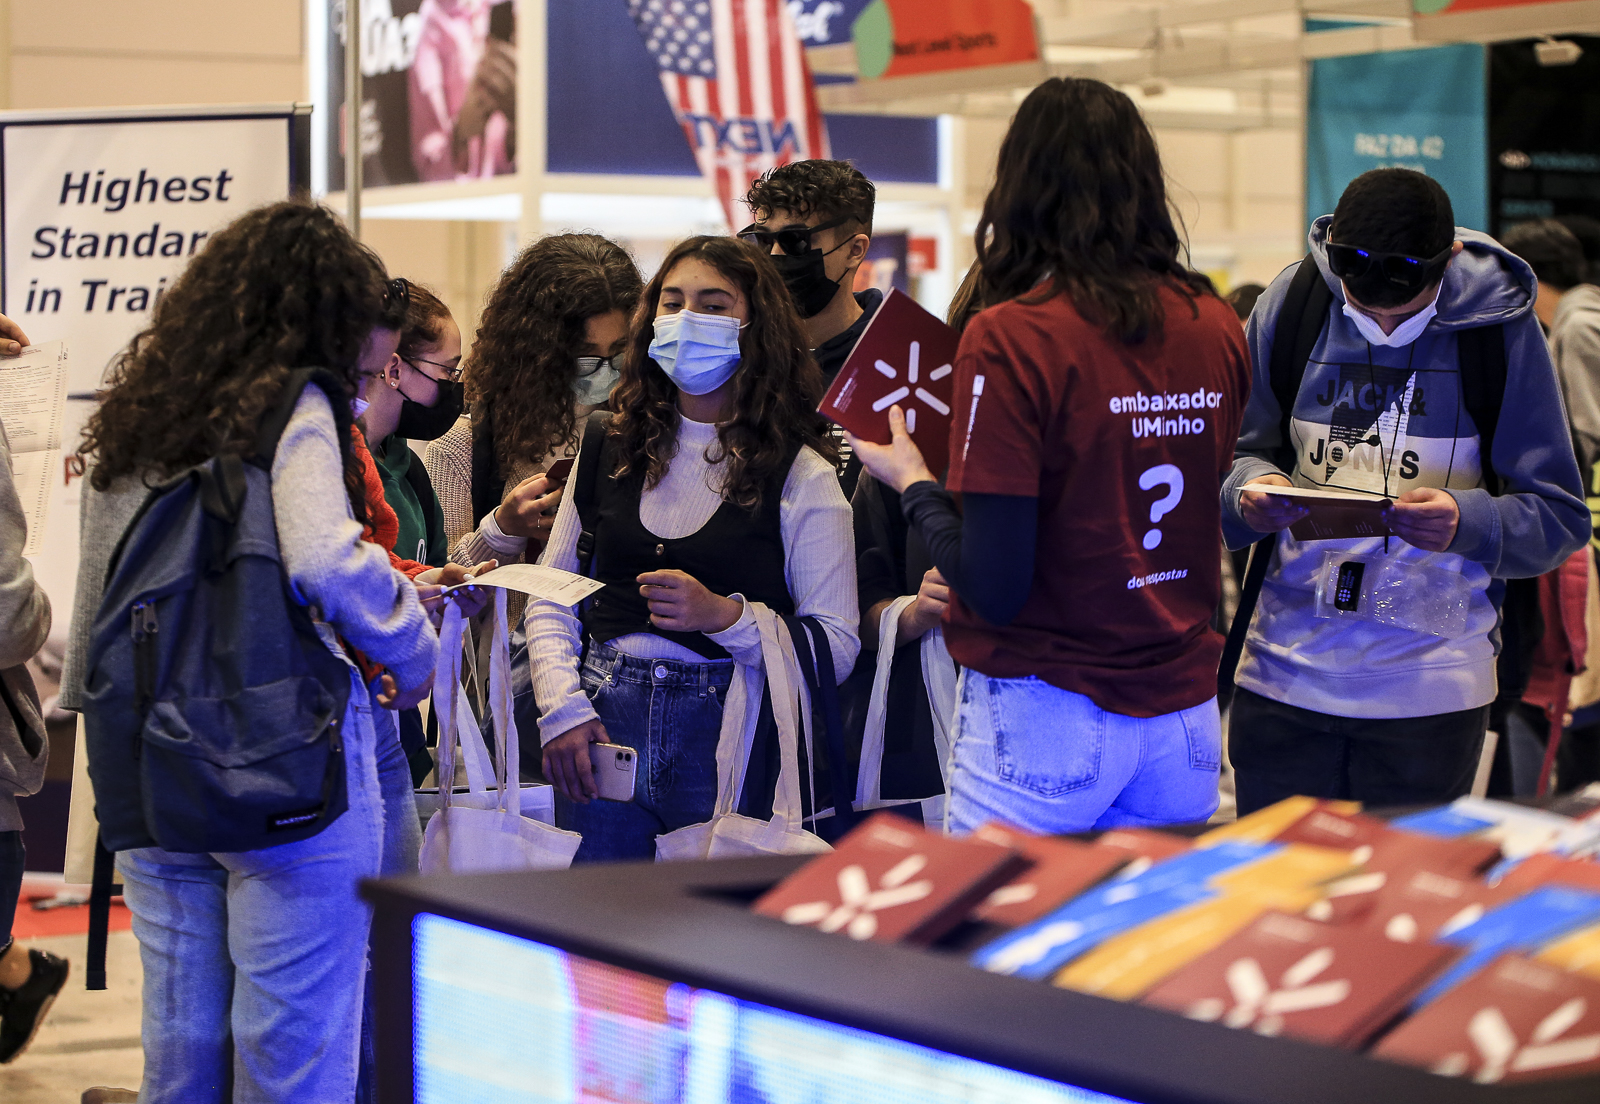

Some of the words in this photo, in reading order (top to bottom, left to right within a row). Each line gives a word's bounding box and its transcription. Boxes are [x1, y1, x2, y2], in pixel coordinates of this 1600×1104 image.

[58, 168, 234, 213] Highest
[25, 278, 63, 314] in
[1108, 386, 1223, 415] embaixador
[1316, 379, 1408, 415] JACK
[1131, 413, 1206, 439] UMinho
[1309, 438, 1420, 480] JONES
